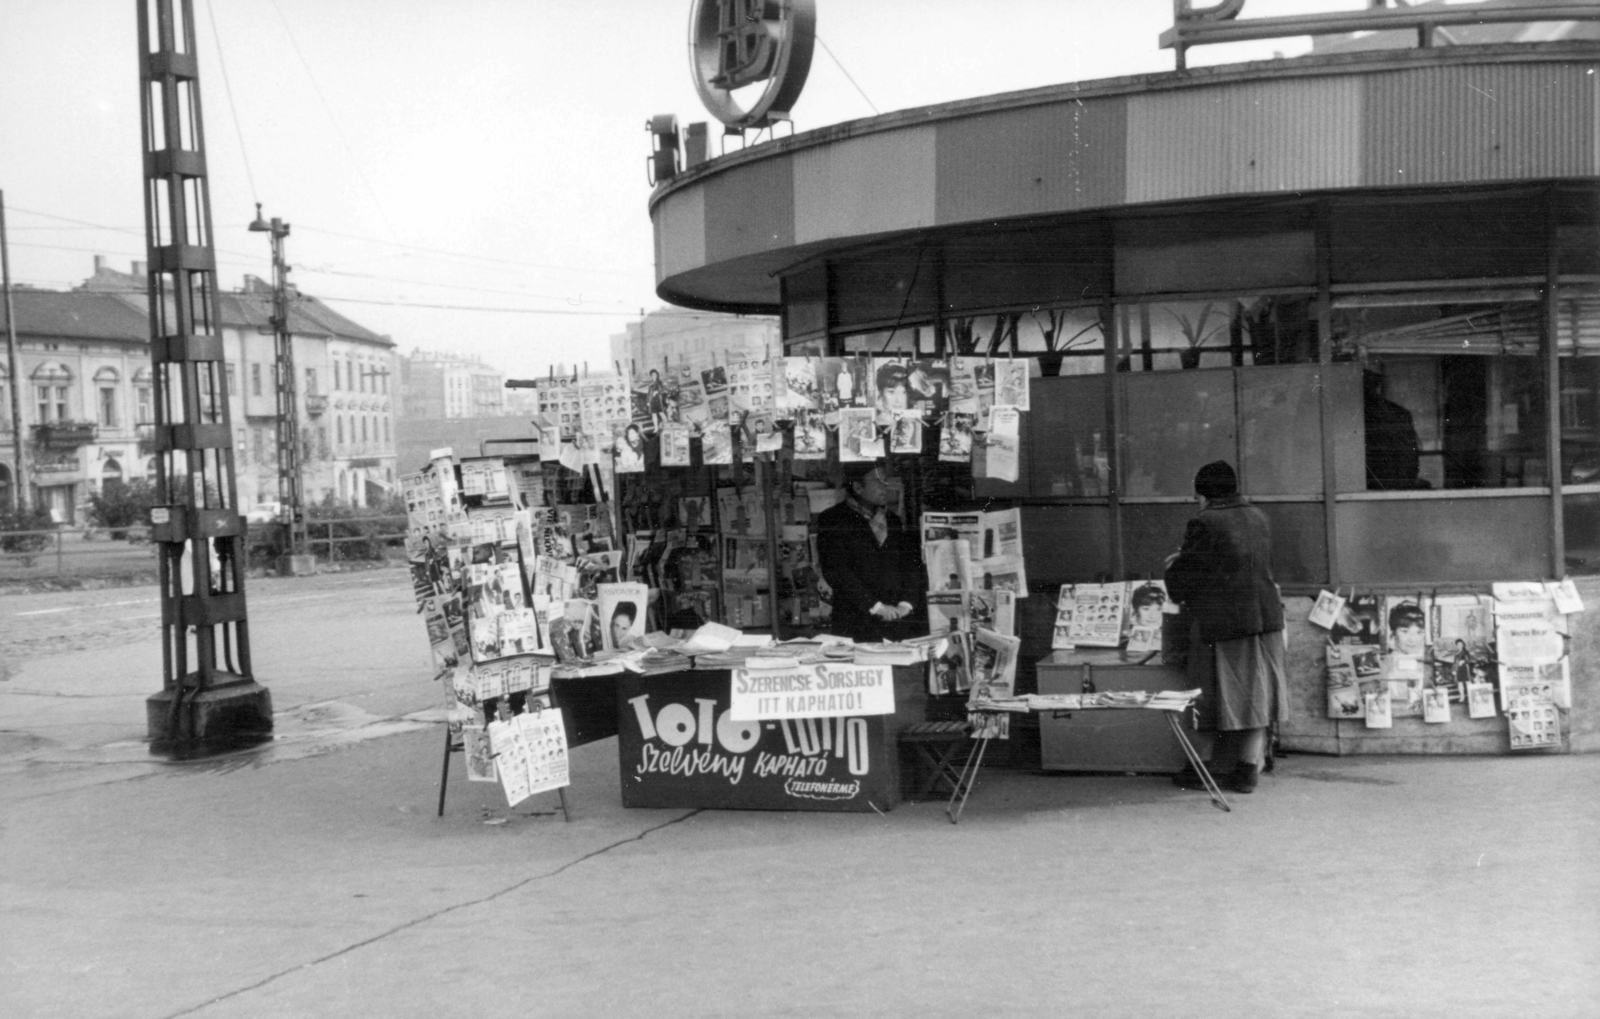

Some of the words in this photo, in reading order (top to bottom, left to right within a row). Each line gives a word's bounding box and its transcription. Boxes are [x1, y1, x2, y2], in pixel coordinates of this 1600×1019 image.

[737, 669, 812, 694] SZERENCSE
[815, 665, 883, 690] SORSJEGY
[758, 697, 780, 714] ITT
[637, 743, 745, 785] Szelvény
[753, 751, 828, 777] KAPHATÓ
[791, 777, 855, 793] TELEFONÉRME
